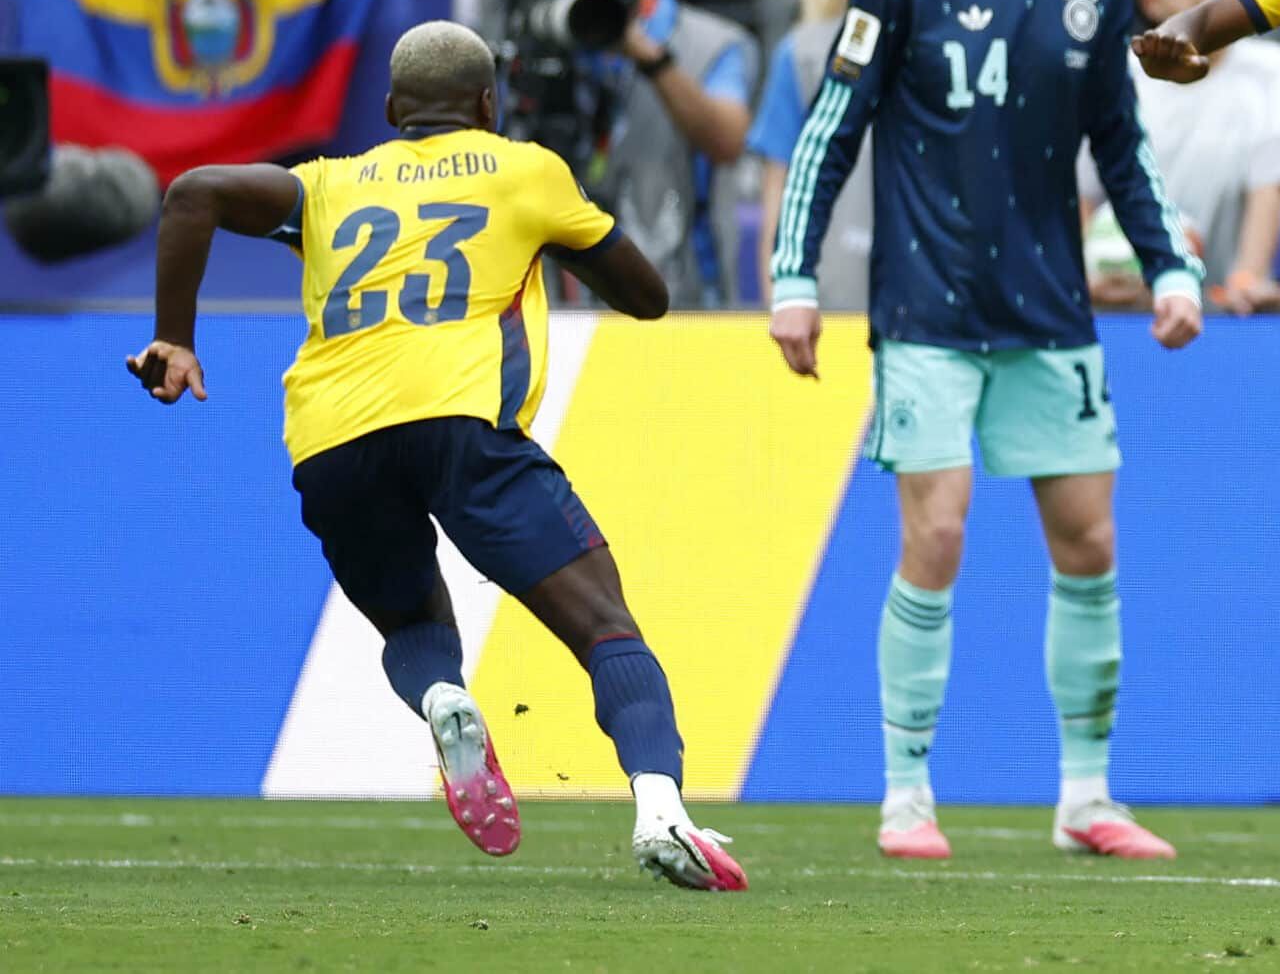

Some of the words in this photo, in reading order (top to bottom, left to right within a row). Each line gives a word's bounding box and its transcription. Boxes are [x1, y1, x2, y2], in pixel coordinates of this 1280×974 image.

[942, 38, 1008, 109] 14
[358, 161, 384, 183] M.
[396, 151, 498, 184] CAICEDO
[322, 201, 489, 340] 23
